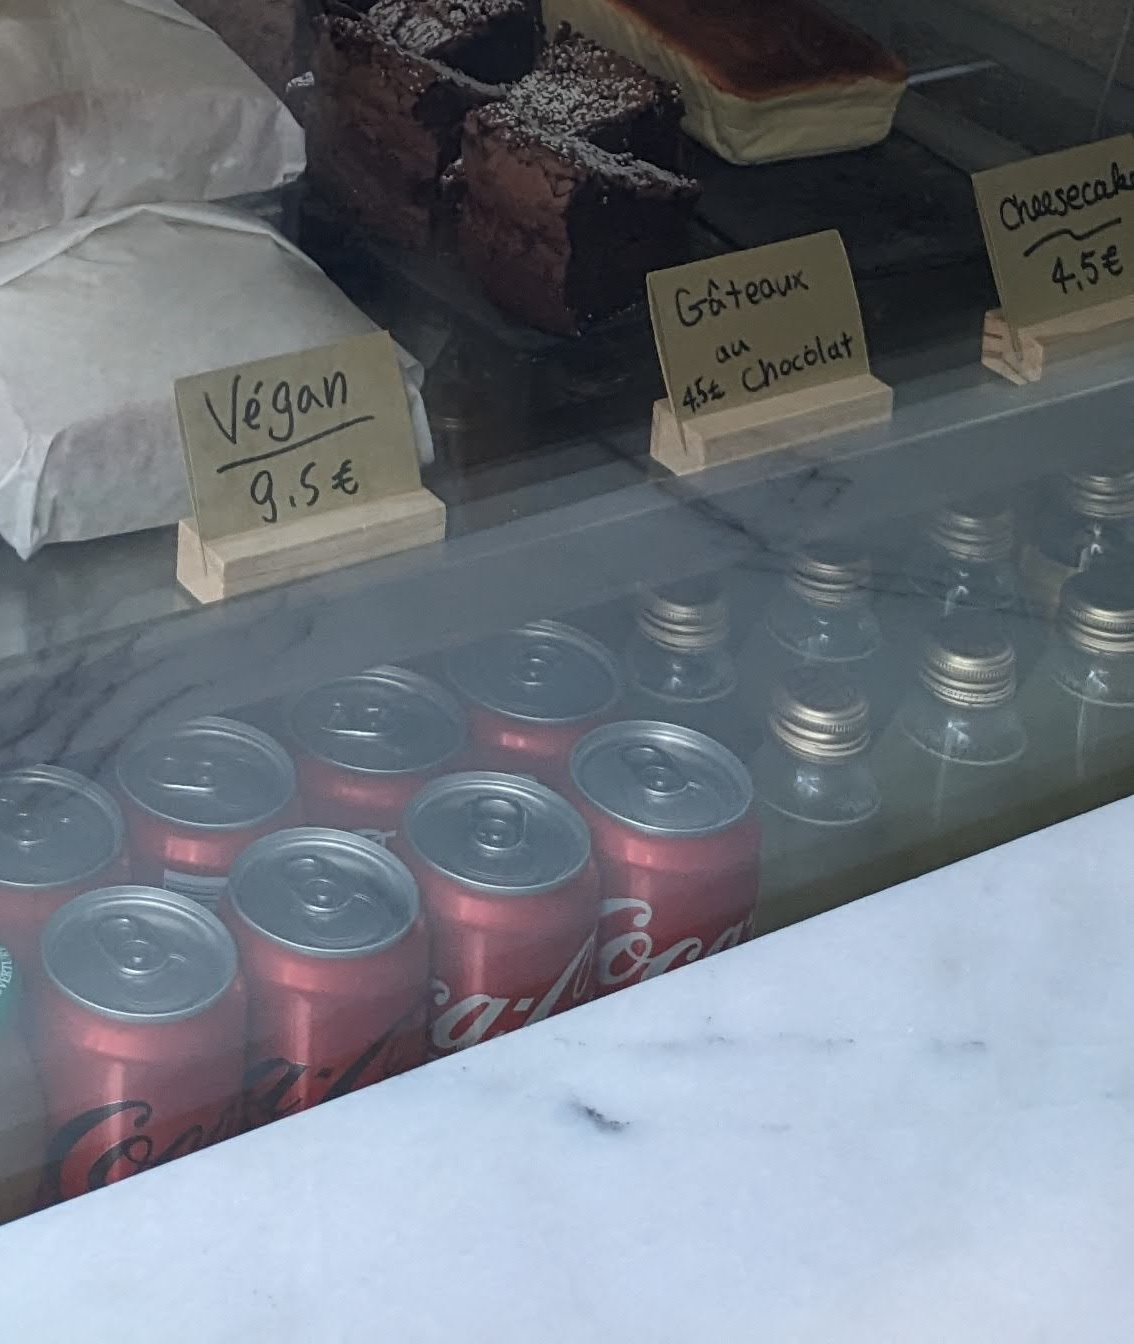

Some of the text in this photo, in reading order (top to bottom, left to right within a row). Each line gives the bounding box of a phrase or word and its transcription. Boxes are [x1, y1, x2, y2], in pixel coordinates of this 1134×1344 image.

[674, 268, 811, 328] Gâteaux
[715, 339, 752, 364] au
[204, 370, 348, 444] Végan
